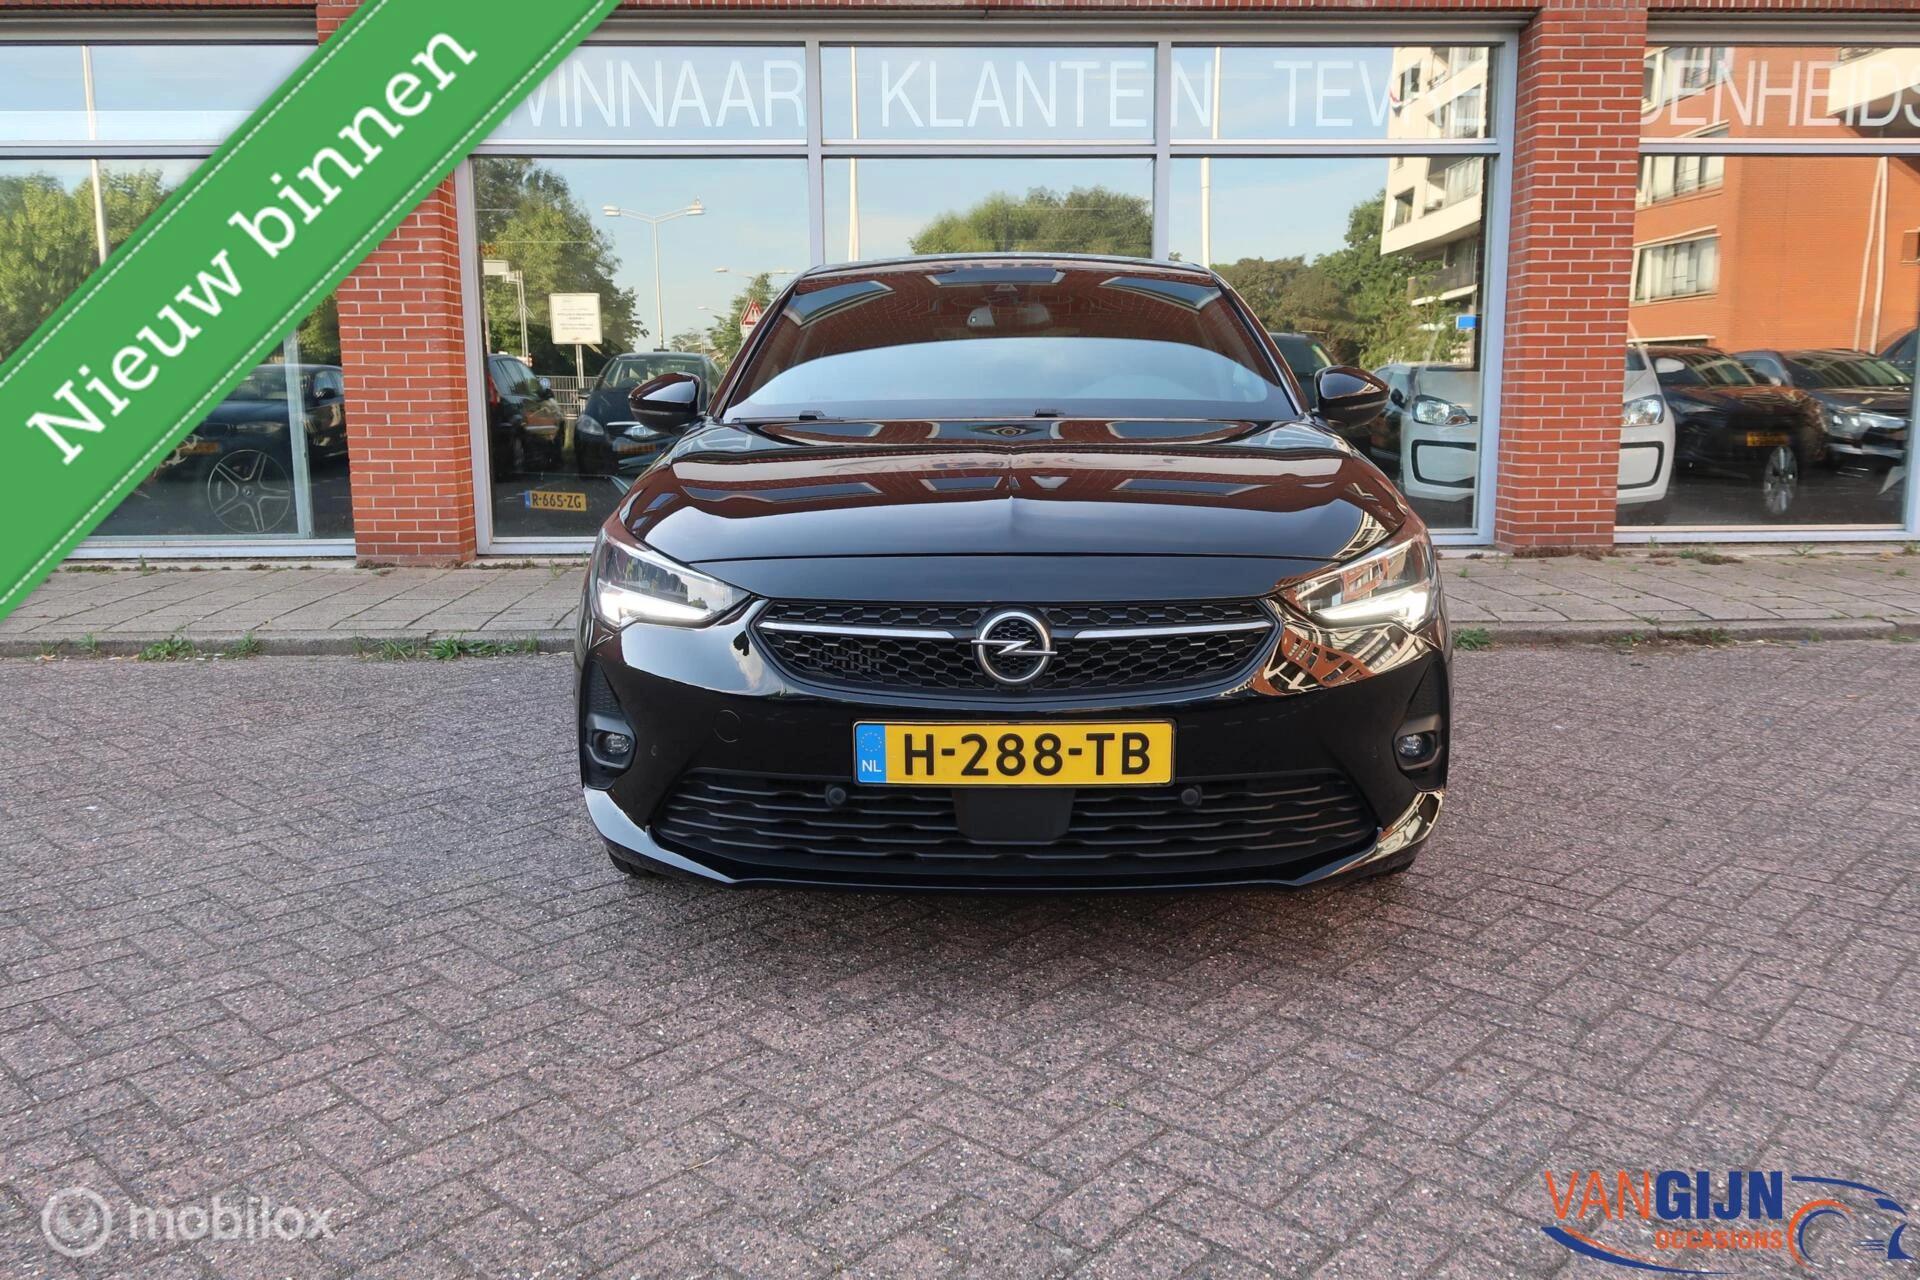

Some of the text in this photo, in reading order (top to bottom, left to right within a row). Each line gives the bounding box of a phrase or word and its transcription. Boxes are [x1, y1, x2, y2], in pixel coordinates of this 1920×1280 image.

[881, 60, 1212, 127] KLANTEN
[532, 493, 581, 508] R-665-ZG
[861, 733, 1150, 777] NL H-288-TB
